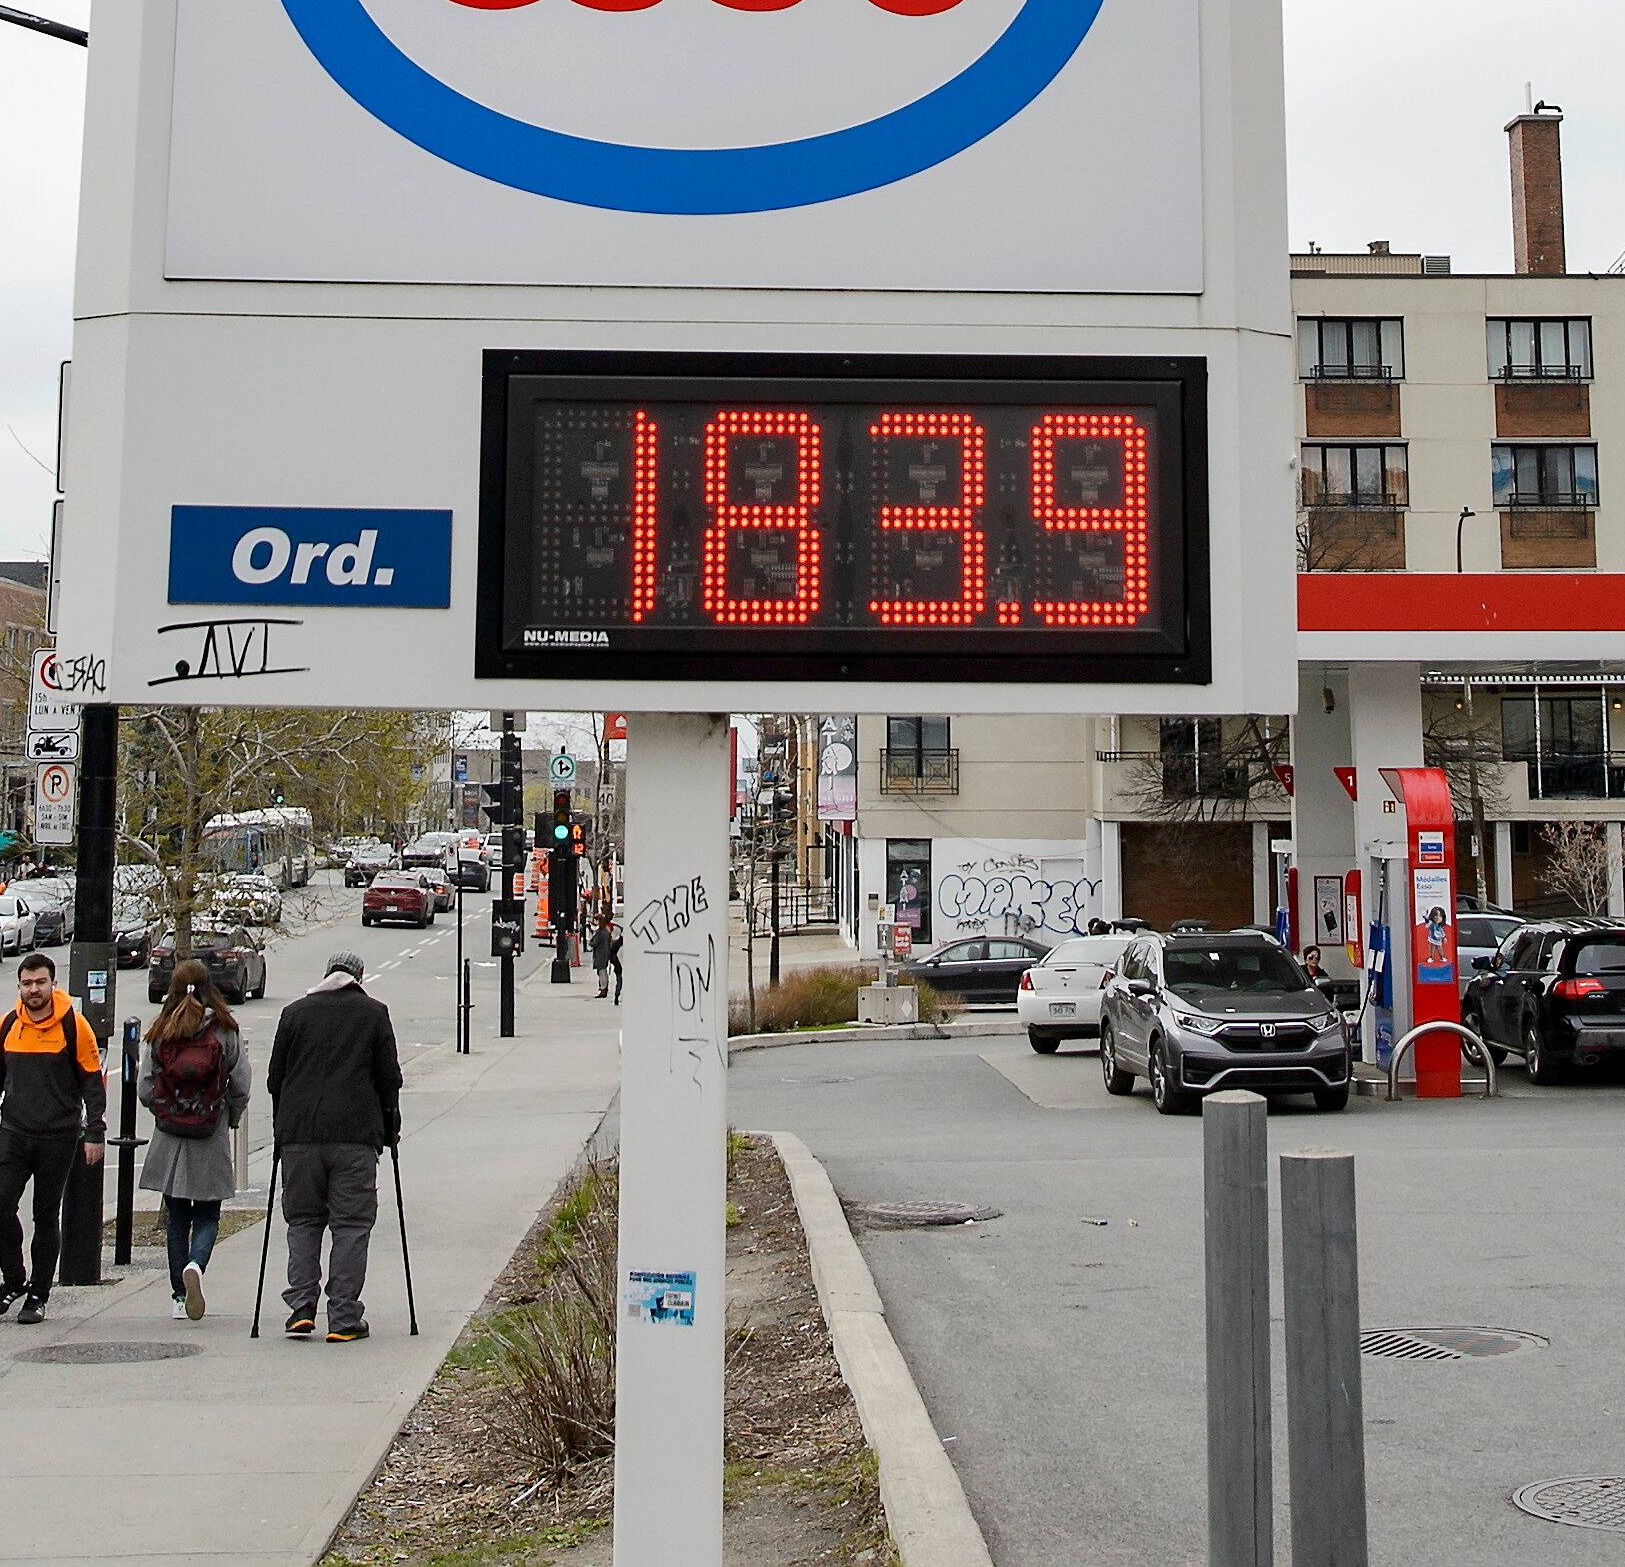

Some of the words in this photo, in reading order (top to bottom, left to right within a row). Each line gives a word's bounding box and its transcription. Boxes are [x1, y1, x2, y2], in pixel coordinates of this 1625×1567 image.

[631, 410, 1150, 627] 183.9
[232, 527, 394, 586] Ord.
[34, 704, 49, 715] LUN
[1285, 773, 1291, 783] 5
[1347, 775, 1354, 786] 1
[630, 875, 709, 945] THE
